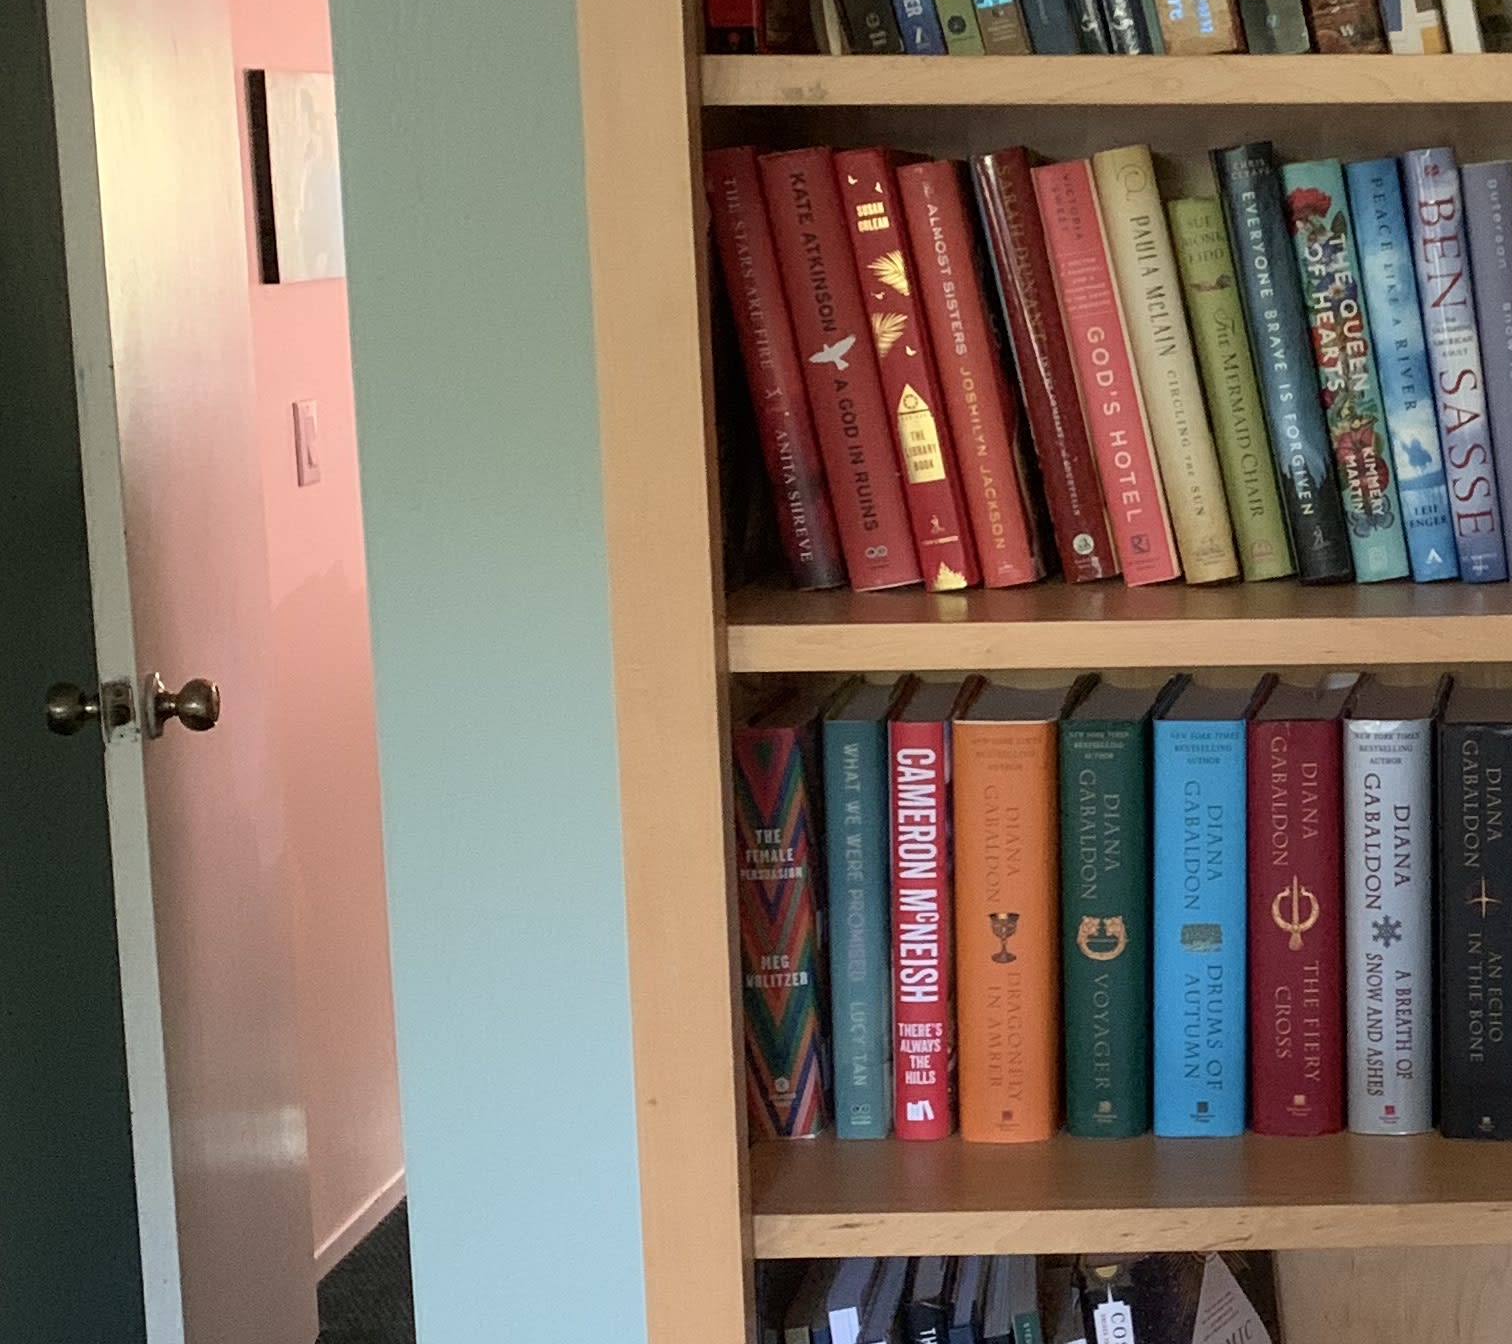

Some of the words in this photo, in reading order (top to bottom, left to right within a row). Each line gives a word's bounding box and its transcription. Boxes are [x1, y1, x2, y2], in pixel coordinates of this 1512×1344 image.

[790, 172, 812, 225] KATE
[801, 233, 836, 333] ATKINSON
[1242, 191, 1271, 300] EVERYONE
[1417, 196, 1467, 309] BEN
[927, 203, 952, 276] ALMOST
[942, 281, 967, 355] SISTERS
[1264, 309, 1287, 372] BRAVE
[834, 379, 848, 390] A
[1279, 384, 1292, 402] IS
[838, 399, 860, 436] GOD
[1087, 326, 1120, 417] GOD'S
[1109, 431, 1142, 523] HOTEL
[1216, 352, 1250, 451] MERMAID
[1242, 454, 1264, 518] CHAIR
[849, 445, 864, 465] IN
[1284, 413, 1313, 517] FORGIVEN
[1439, 368, 1494, 539] SASSE
[853, 472, 878, 532] RUINS
[896, 749, 936, 879] CAMERON
[1271, 736, 1288, 867] GABALDON
[1301, 762, 1317, 839] DIANA
[1364, 773, 1382, 910] GABALDON
[1394, 804, 1411, 888] DIANA
[1366, 953, 1382, 1001] SNOW
[1395, 970, 1411, 980] A
[898, 1023, 942, 1036] THERE'S
[1207, 965, 1223, 1049] DRUMS
[1275, 985, 1291, 1059] CROSS
[1367, 1007, 1383, 1042] AND
[1396, 988, 1412, 1052] BREATH
[900, 1039, 941, 1052] ALWAYS
[910, 1055, 931, 1069] THE
[1207, 1064, 1223, 1090] OF
[1367, 1047, 1383, 1096] ASHES
[1397, 1058, 1412, 1079] OF
[905, 1071, 936, 1084] HILLS
